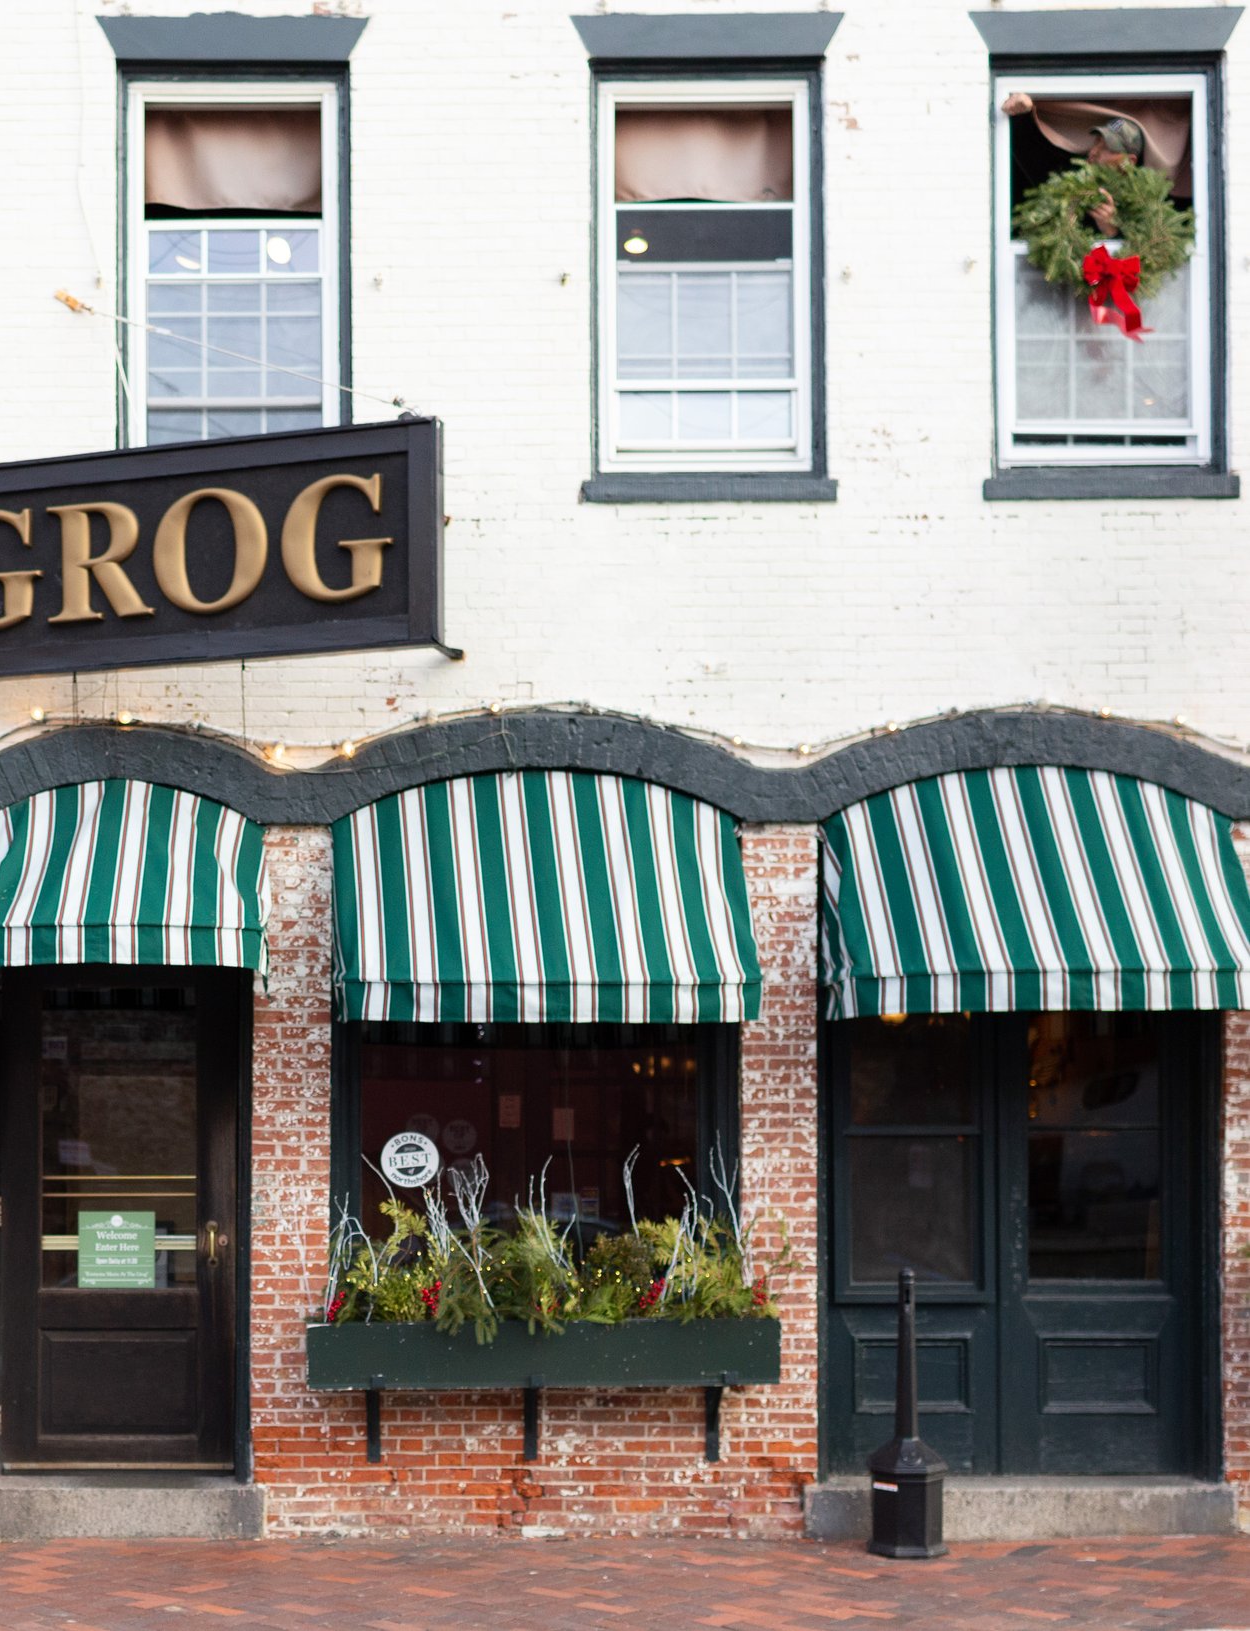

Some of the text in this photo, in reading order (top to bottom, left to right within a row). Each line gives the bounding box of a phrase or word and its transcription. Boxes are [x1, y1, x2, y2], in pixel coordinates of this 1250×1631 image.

[394, 1135, 424, 1146] BONS
[389, 1153, 432, 1168] BEST
[96, 1230, 138, 1240] Welcome
[95, 1243, 140, 1252] Enter Here
